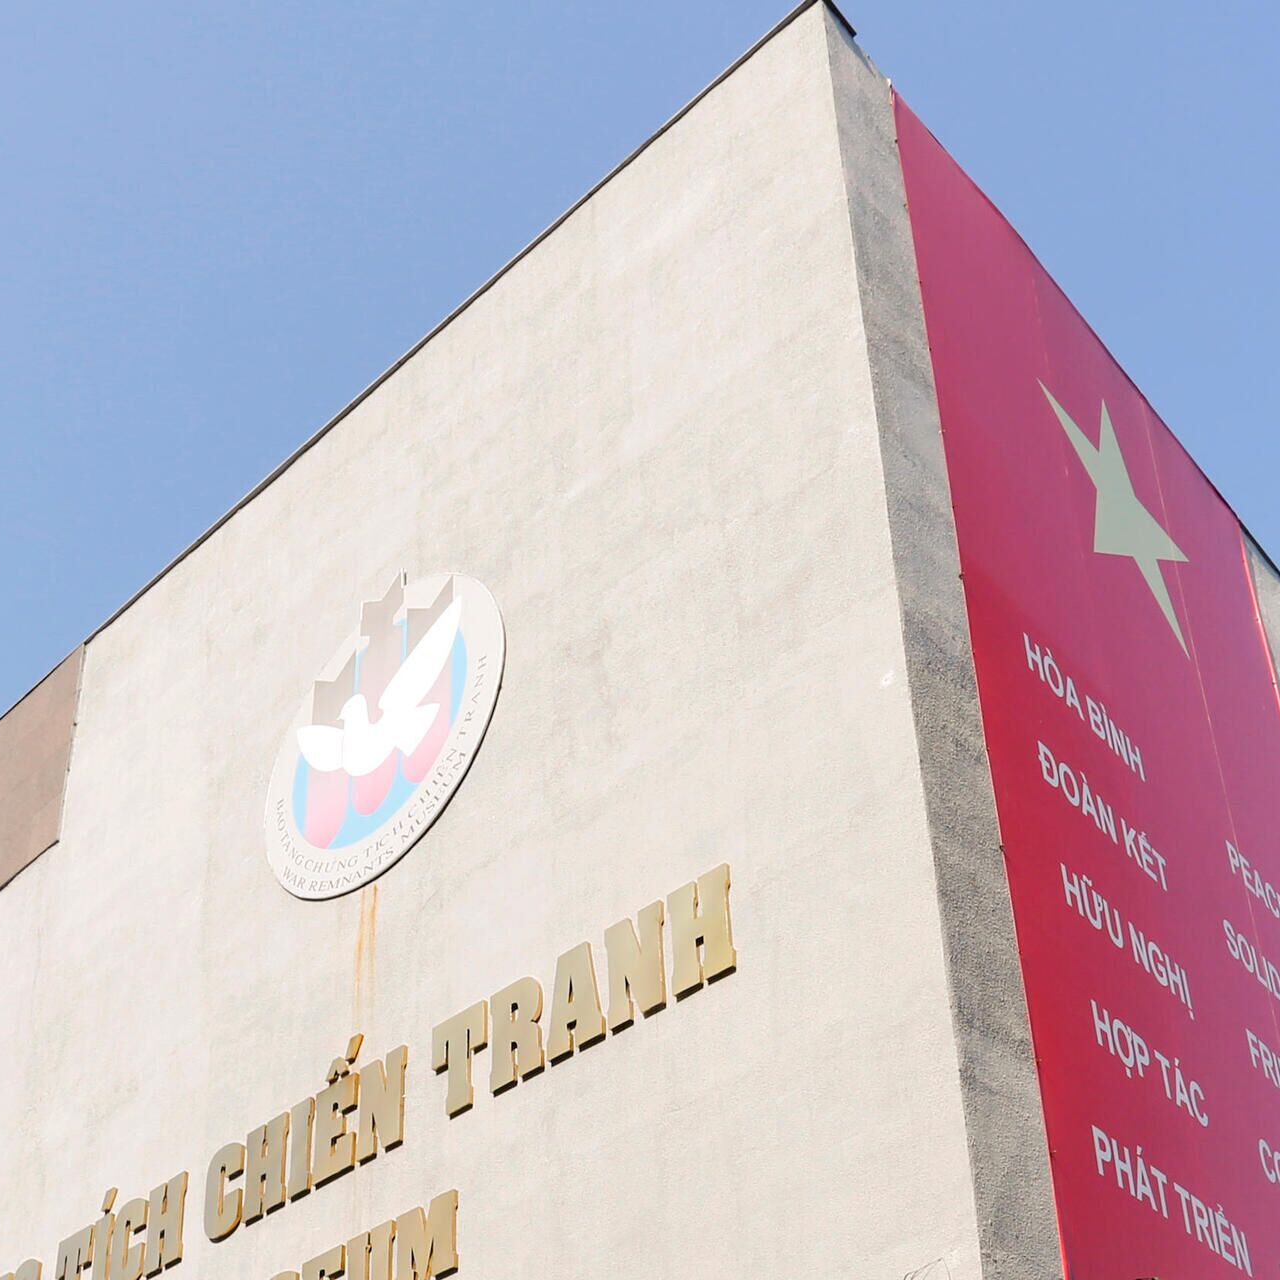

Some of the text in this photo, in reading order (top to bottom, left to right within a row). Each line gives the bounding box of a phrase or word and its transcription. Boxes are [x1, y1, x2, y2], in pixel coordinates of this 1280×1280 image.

[1023, 632, 1146, 782] HÒA BÌNH
[282, 752, 466, 892] WAR REMNANTS MUSEUM
[1038, 740, 1168, 892] ĐOÀN KẾT
[1060, 863, 1195, 1021] HỮU NGHỊ
[203, 1033, 409, 1244] CHIẾN
[432, 862, 738, 1120] TRANH
[1090, 999, 1209, 1128] HỢP TÁC
[1091, 1124, 1253, 1278] PHÁT TRIỂN
